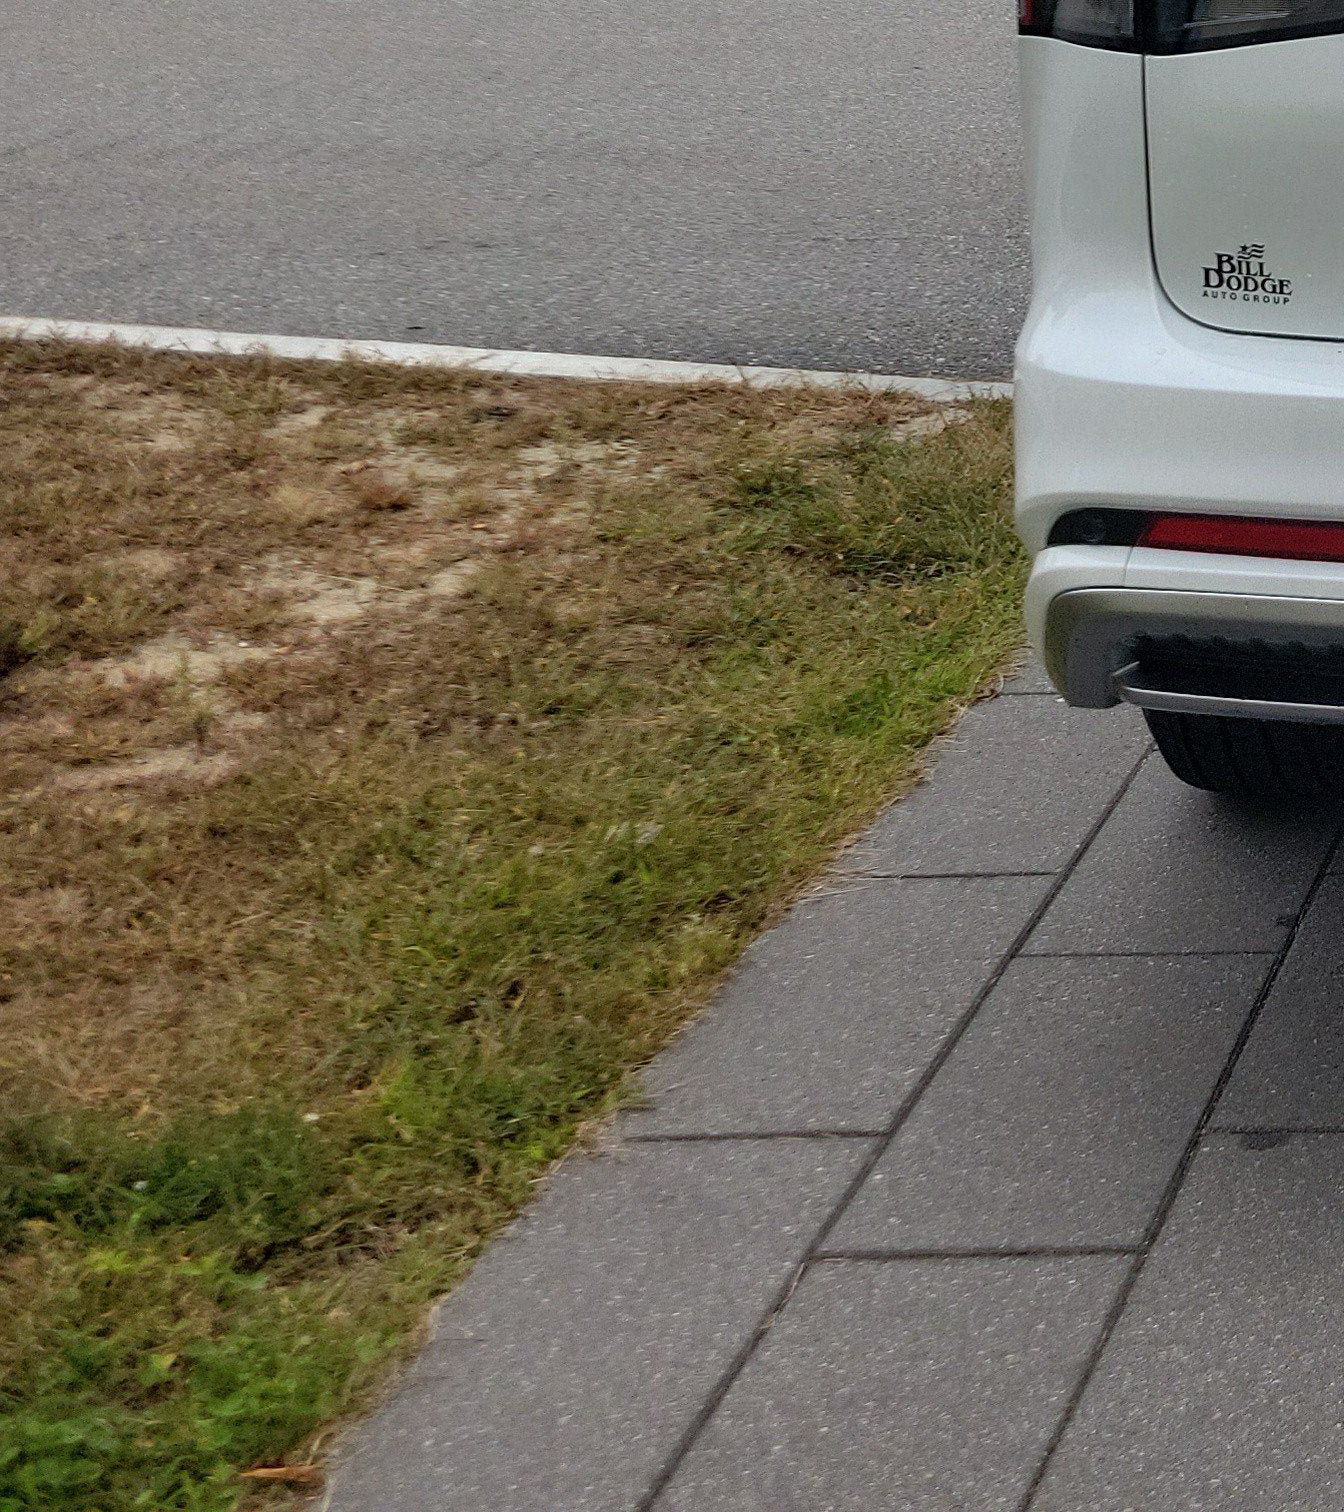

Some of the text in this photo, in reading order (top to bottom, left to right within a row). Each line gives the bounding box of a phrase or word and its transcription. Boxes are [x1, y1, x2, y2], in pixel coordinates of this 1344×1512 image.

[1214, 252, 1272, 278] BILL
[1201, 266, 1293, 296] DODGE
[1202, 290, 1290, 305] AUTO GROUP
